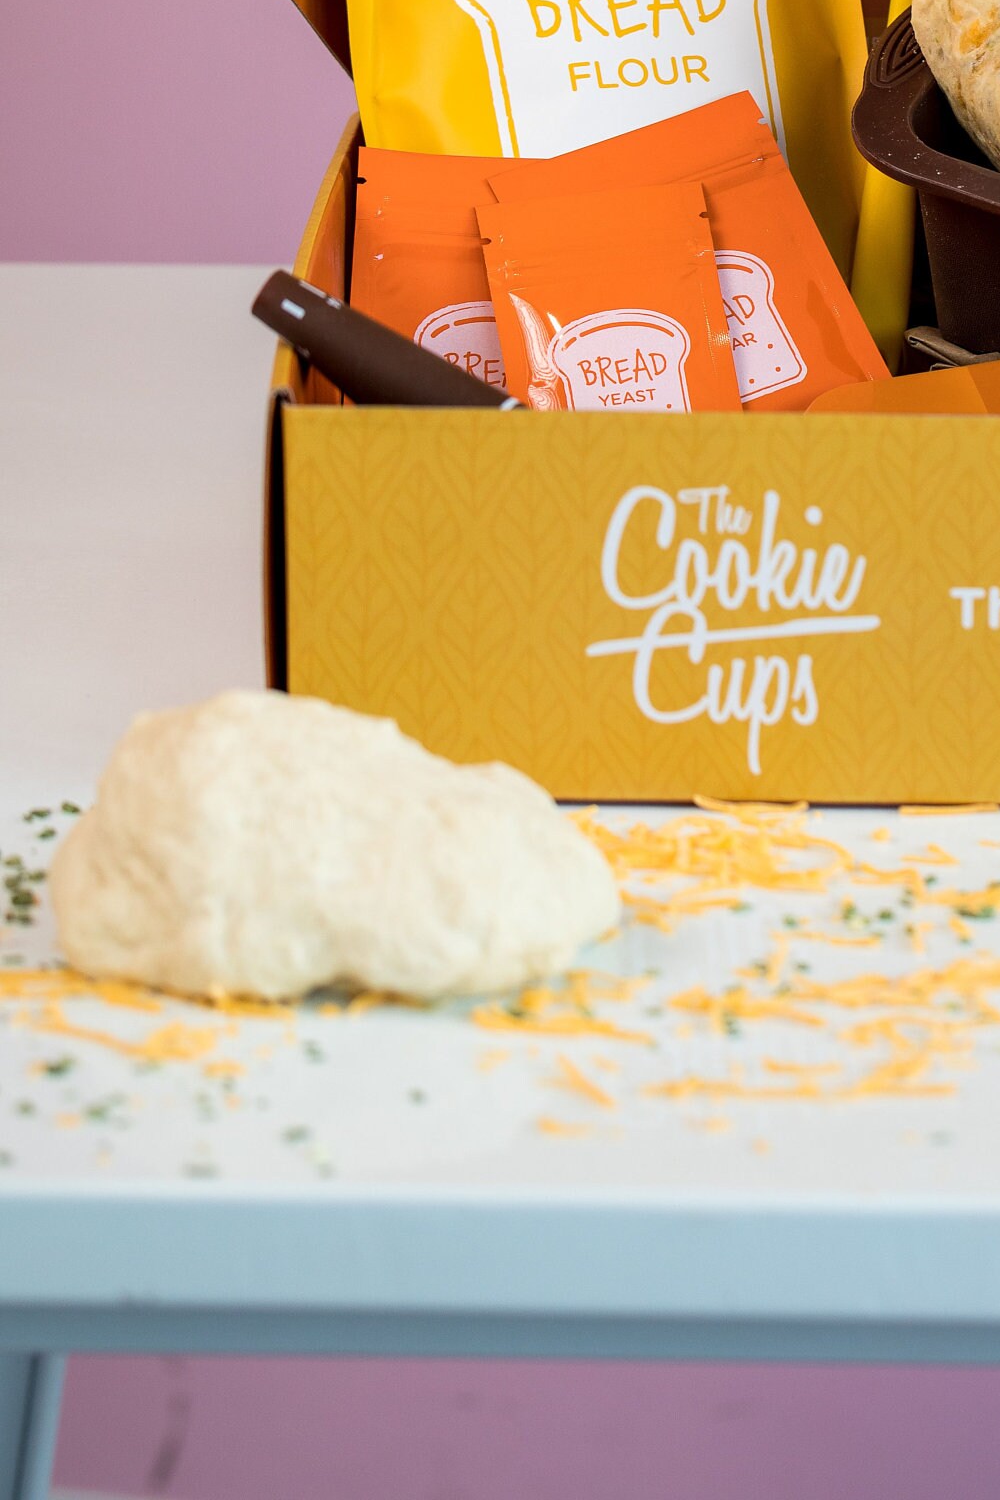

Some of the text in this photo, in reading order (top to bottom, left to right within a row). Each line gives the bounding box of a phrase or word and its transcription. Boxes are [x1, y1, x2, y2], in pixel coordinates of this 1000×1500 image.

[567, 55, 710, 92] FLOUR
[443, 351, 507, 388] BRE
[577, 348, 667, 388] BREAD
[598, 388, 657, 407] YEAST
[676, 484, 753, 535] The
[601, 484, 867, 612] Cookie
[632, 600, 819, 776] Cups
